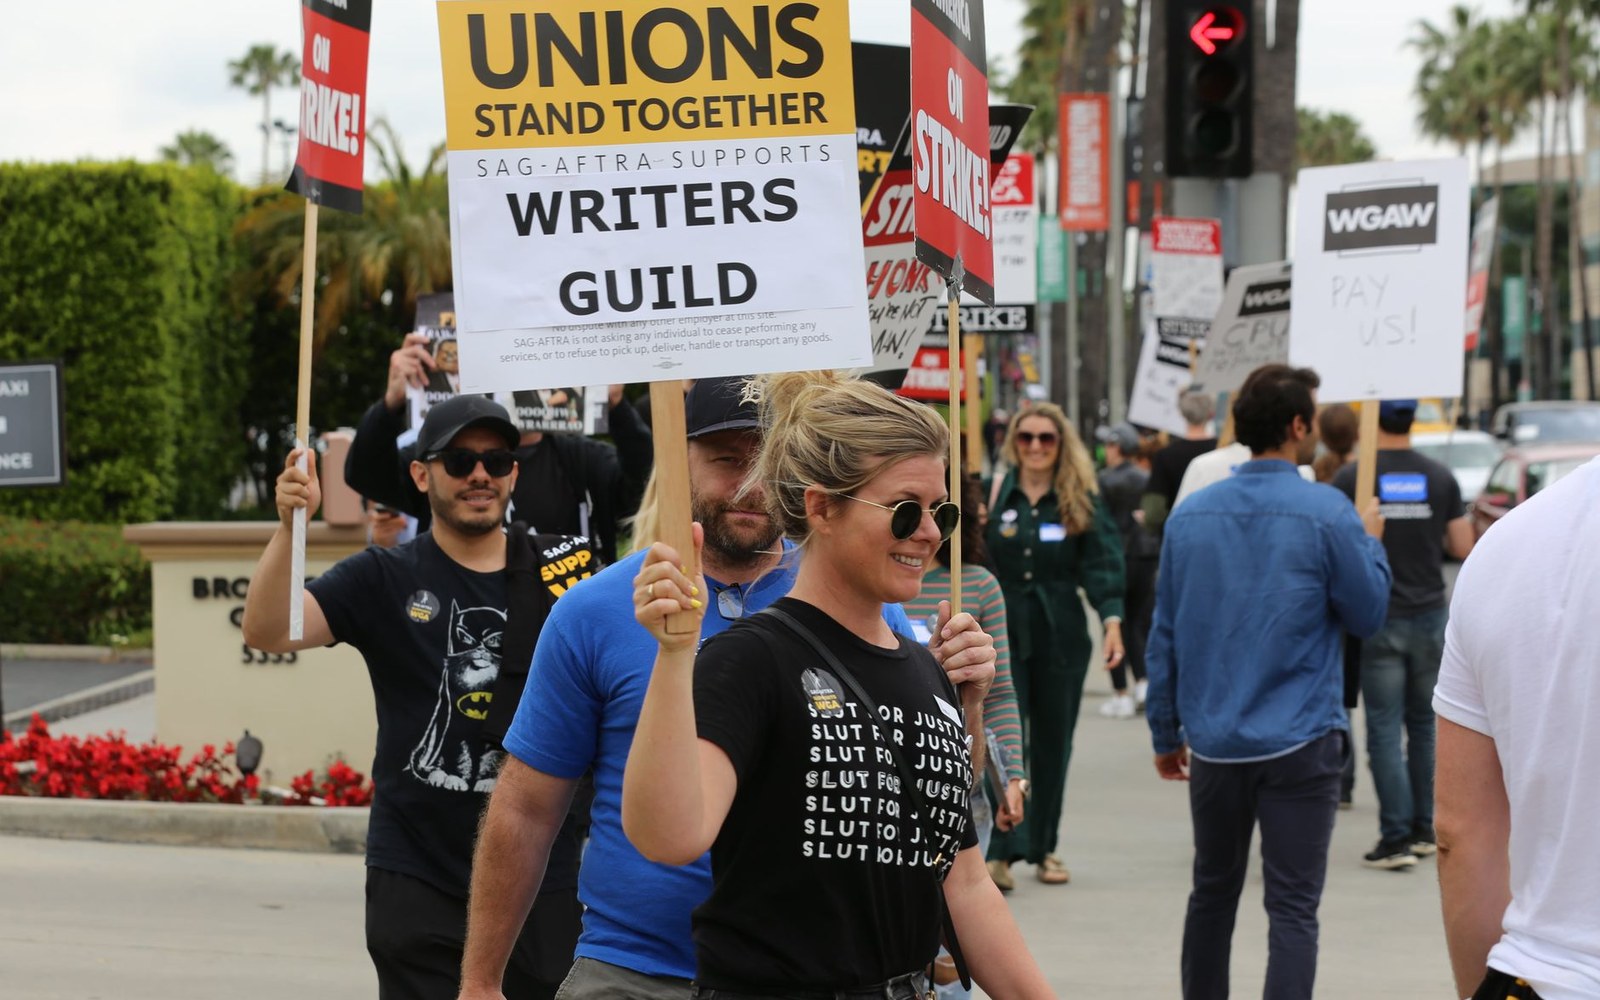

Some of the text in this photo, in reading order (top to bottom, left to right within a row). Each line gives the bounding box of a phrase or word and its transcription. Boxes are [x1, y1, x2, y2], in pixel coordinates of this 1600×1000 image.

[312, 33, 331, 74] ON
[467, 3, 824, 90] UNIONS
[947, 67, 963, 124] ON
[475, 92, 829, 138] STAND TOGETHER
[477, 144, 830, 177] SAG-AFTRA SUPPORTS
[917, 109, 990, 240] STRIKE!
[506, 178, 798, 237] WRITERS
[1327, 202, 1436, 233] WGAW
[559, 262, 757, 316] GUILD
[1331, 273, 1390, 309] PAY
[514, 322, 816, 348] SAG-AFTRA is not asking any individual to cease performing any
[568, 323, 606, 332] dispute
[607, 320, 628, 328] with
[630, 320, 647, 329] any
[650, 317, 676, 325] other
[678, 315, 723, 325] employer
[725, 313, 735, 321] at
[737, 312, 755, 320] this
[757, 311, 777, 319] site.
[500, 352, 541, 362] services,
[555, 351, 565, 359] to
[568, 347, 597, 358] refuse
[600, 347, 609, 356] to
[612, 344, 632, 357] pick
[634, 346, 650, 356] up,
[652, 341, 686, 355] deliver,
[688, 338, 721, 350] handle
[723, 340, 733, 348] or
[735, 337, 780, 348] transport
[782, 336, 799, 346] any
[801, 332, 833, 346] goods.
[815, 700, 842, 711] WGA
[868, 704, 904, 724] OR
[811, 723, 863, 741] SLUT
[871, 724, 904, 746] FR
[810, 746, 867, 762] SLUT
[875, 746, 897, 768] FO
[805, 770, 870, 788] SLUT
[878, 771, 901, 794] FOR
[805, 795, 872, 813] SLUT
[804, 818, 871, 838] SLUT
[802, 841, 869, 862] SLUT
